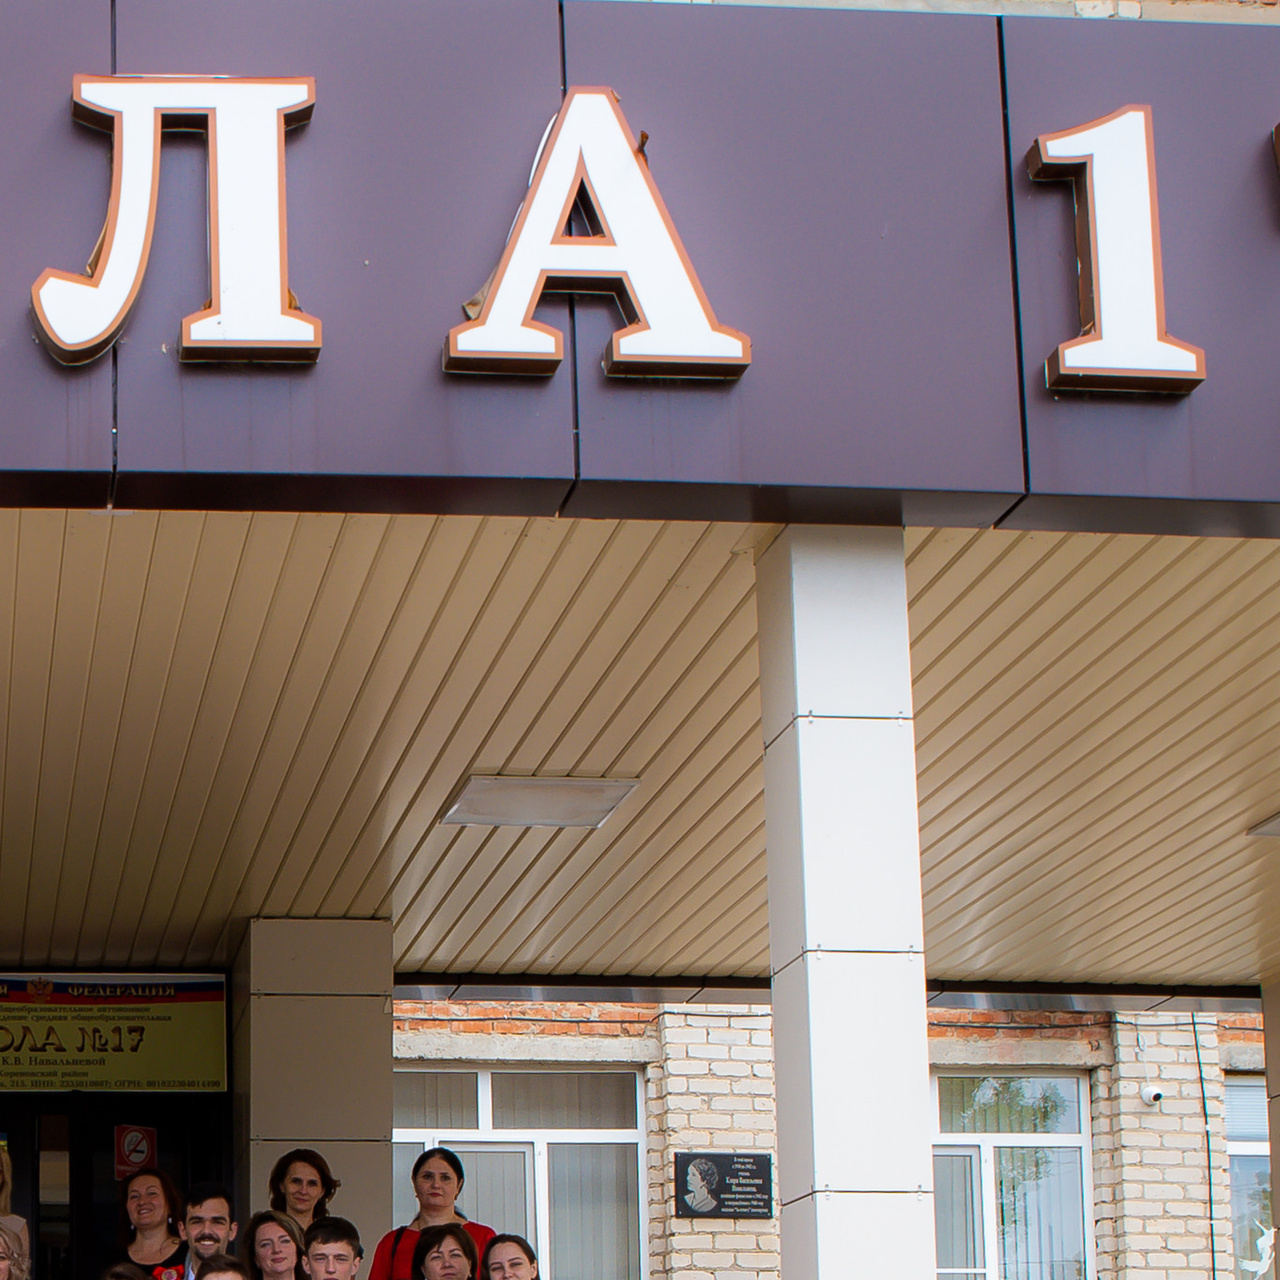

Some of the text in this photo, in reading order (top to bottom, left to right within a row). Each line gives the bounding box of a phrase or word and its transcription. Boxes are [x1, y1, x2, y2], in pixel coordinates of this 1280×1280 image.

[1028, 104, 1280, 394] 1
[67, 983, 177, 997] ФЕДЕРАЦИЯ
[76, 1025, 146, 1053] №17
[1, 1057, 24, 1066] К.В.
[29, 1056, 106, 1066] Навальневой
[61, 1069, 89, 1079] район
